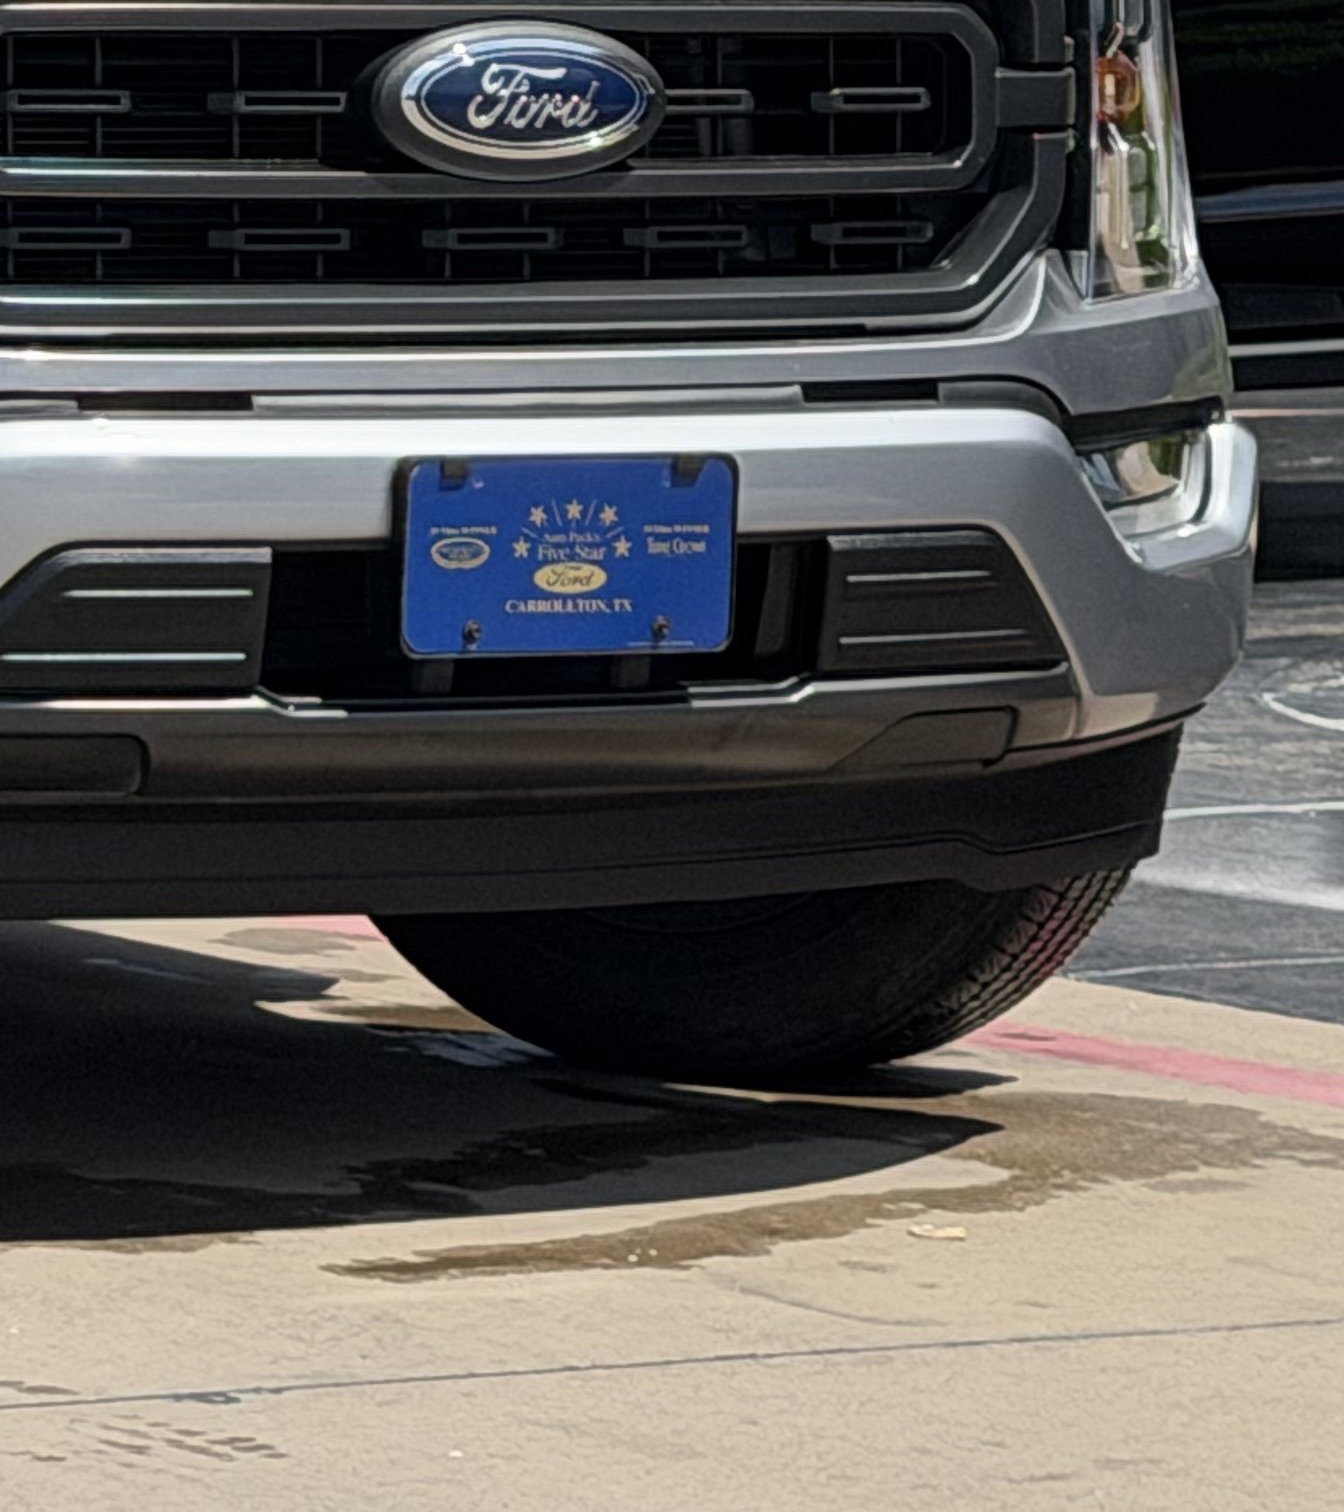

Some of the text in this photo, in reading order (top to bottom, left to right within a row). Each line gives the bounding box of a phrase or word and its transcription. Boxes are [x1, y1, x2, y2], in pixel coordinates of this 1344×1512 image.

[467, 62, 599, 129] Ford
[537, 544, 607, 561] Five Star
[545, 565, 596, 587] Ford
